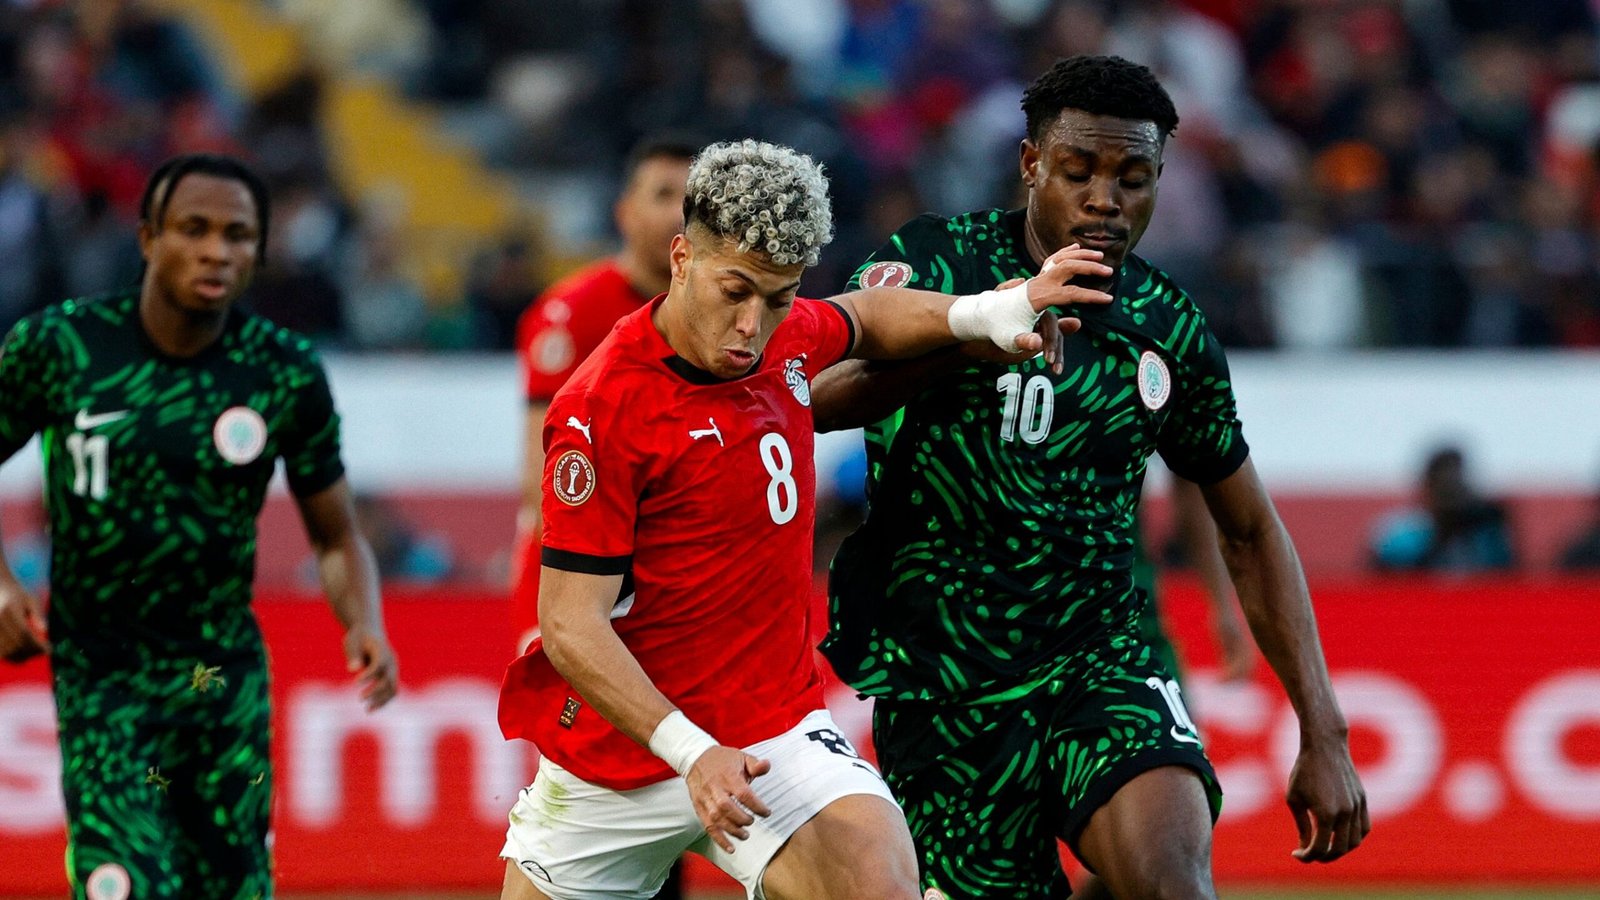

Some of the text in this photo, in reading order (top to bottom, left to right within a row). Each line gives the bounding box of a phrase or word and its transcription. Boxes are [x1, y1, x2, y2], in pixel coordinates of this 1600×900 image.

[997, 372, 1054, 444] 10
[65, 432, 109, 499] 11
[759, 432, 799, 526] 8
